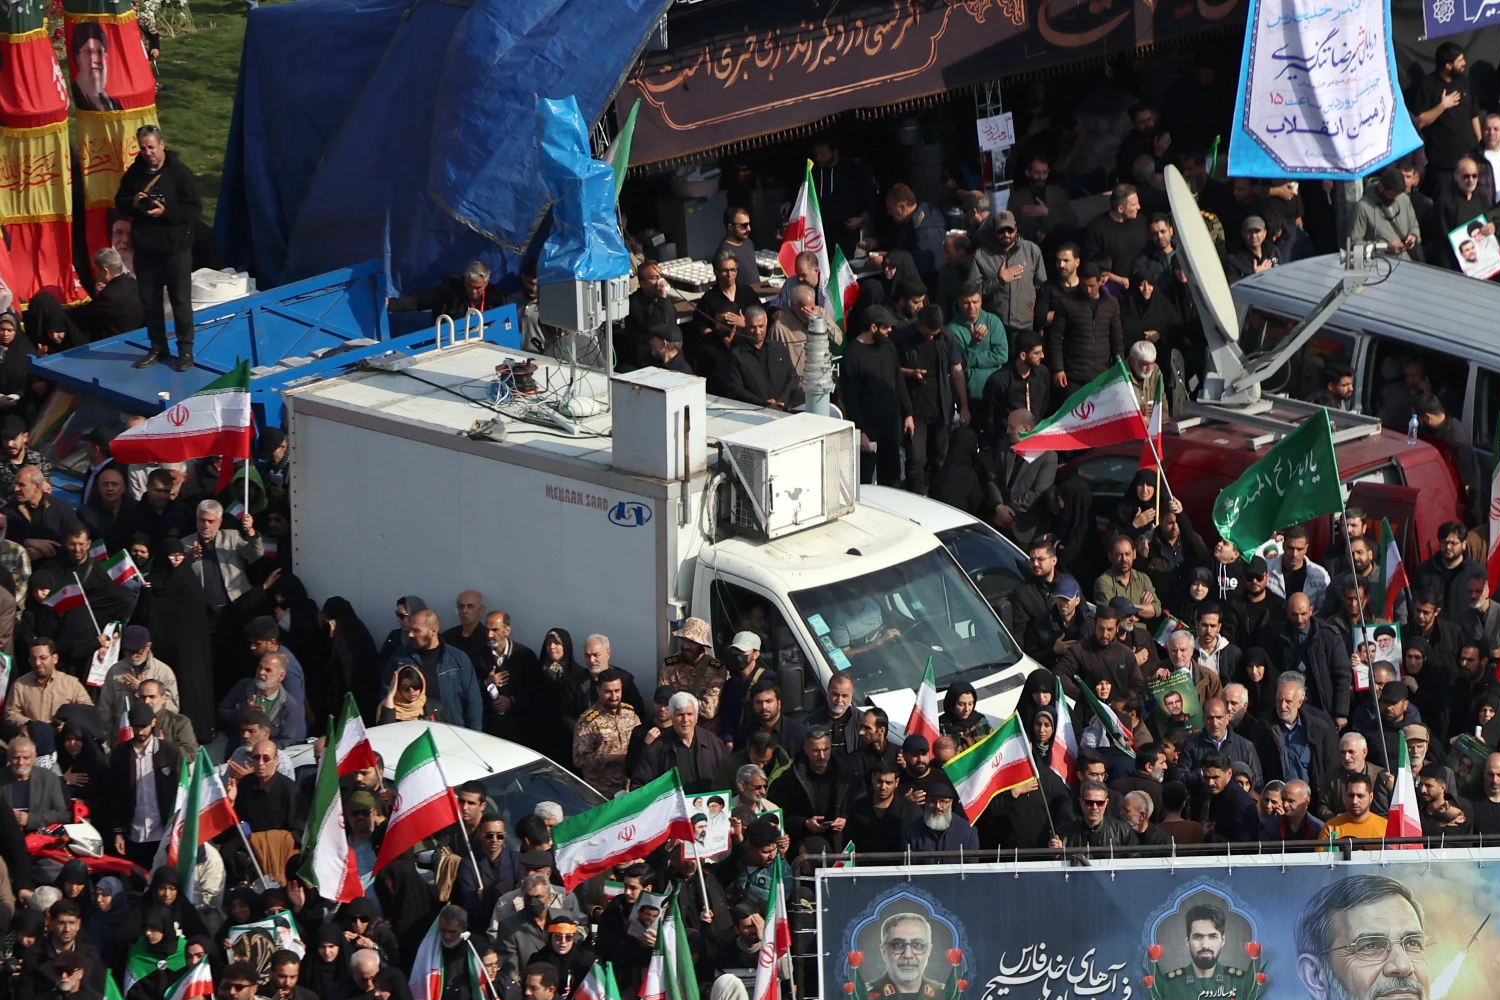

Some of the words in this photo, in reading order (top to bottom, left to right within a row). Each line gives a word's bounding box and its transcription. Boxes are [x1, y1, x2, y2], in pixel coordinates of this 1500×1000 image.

[645, 45, 713, 93] است
[1285, 96, 1322, 110] ساعت
[1265, 115, 1344, 139] انقلاب
